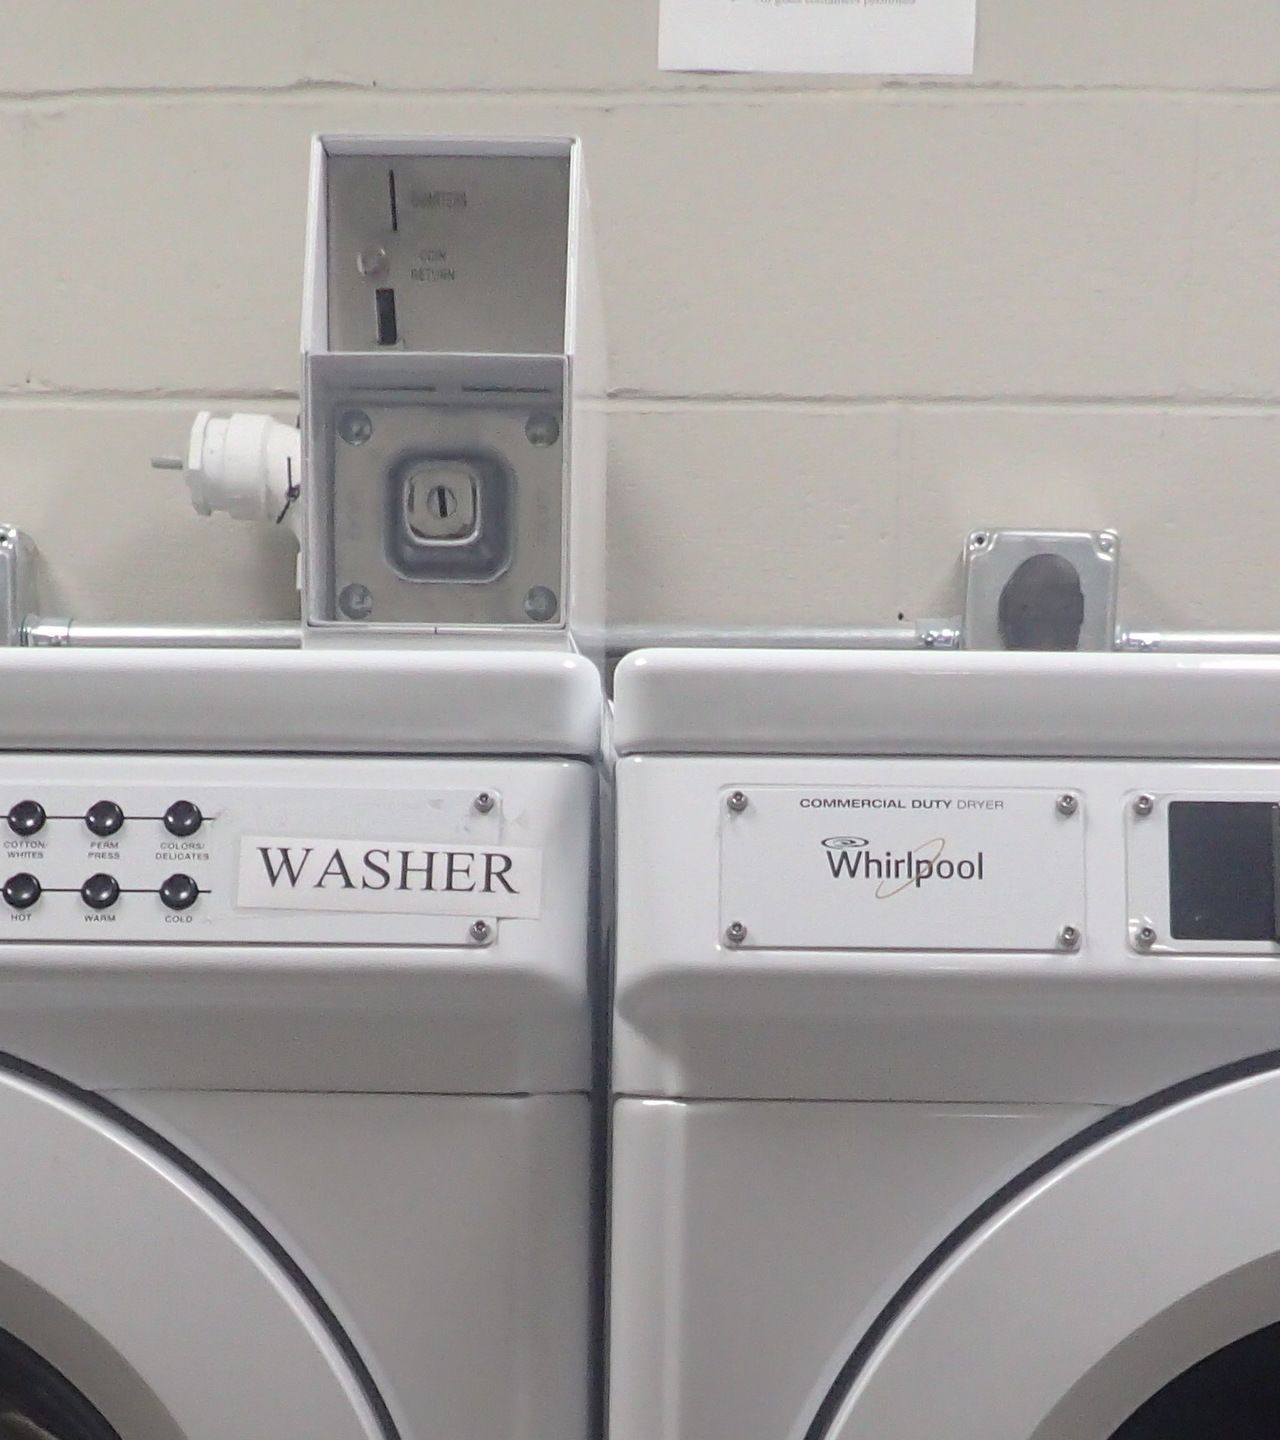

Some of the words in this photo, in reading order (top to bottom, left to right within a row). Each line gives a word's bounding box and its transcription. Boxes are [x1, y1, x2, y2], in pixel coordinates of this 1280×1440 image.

[800, 798, 906, 809] COMMERCIAL
[911, 799, 952, 809] DUTY
[956, 800, 1005, 810] DRYER
[90, 841, 119, 849] PERM
[88, 852, 120, 860] PRESS
[155, 852, 210, 861] DELICATES
[257, 845, 520, 895] WASHER
[825, 850, 984, 888] Whirlpool
[10, 914, 32, 922] HOT
[164, 915, 193, 924] COLD
